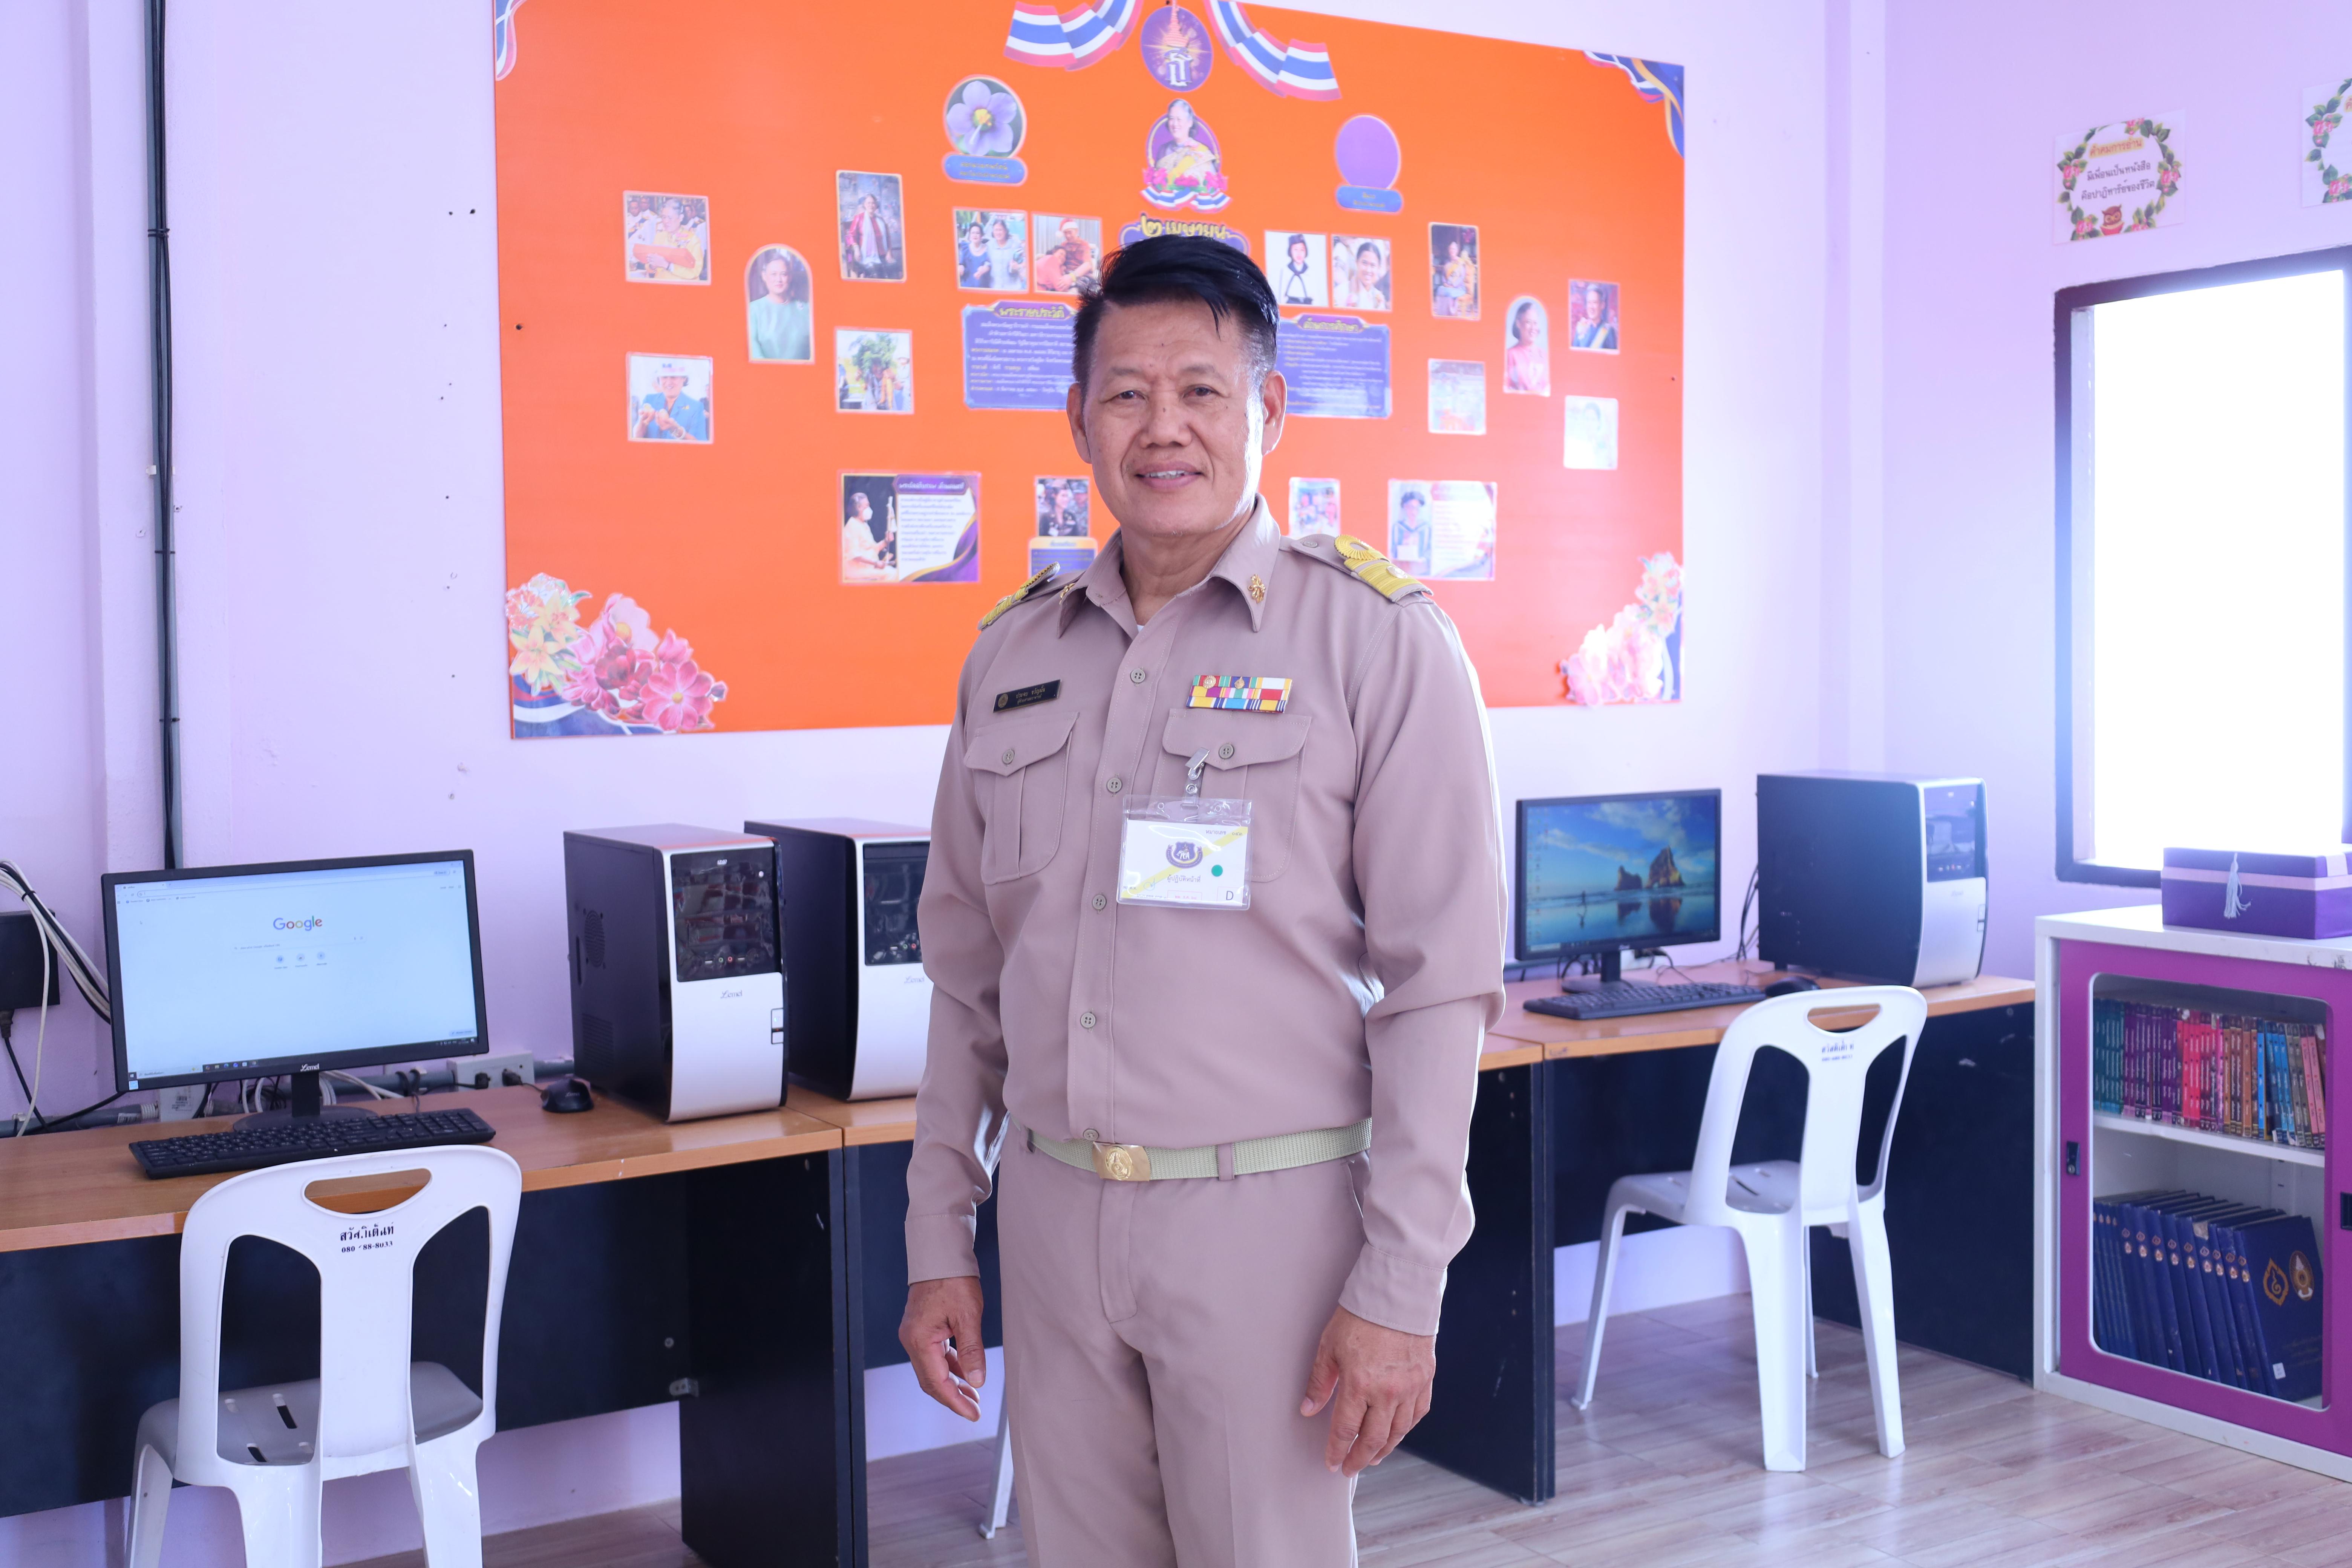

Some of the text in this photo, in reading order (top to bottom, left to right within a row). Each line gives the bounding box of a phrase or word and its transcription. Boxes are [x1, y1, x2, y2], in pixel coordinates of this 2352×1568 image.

[1167, 874, 1201, 883] ผู้ปฏิบัติหน้าที่
[1226, 891, 1234, 900] D
[273, 915, 323, 931] Google
[720, 990, 742, 999] Lemel
[300, 1063, 319, 1072] Lemel
